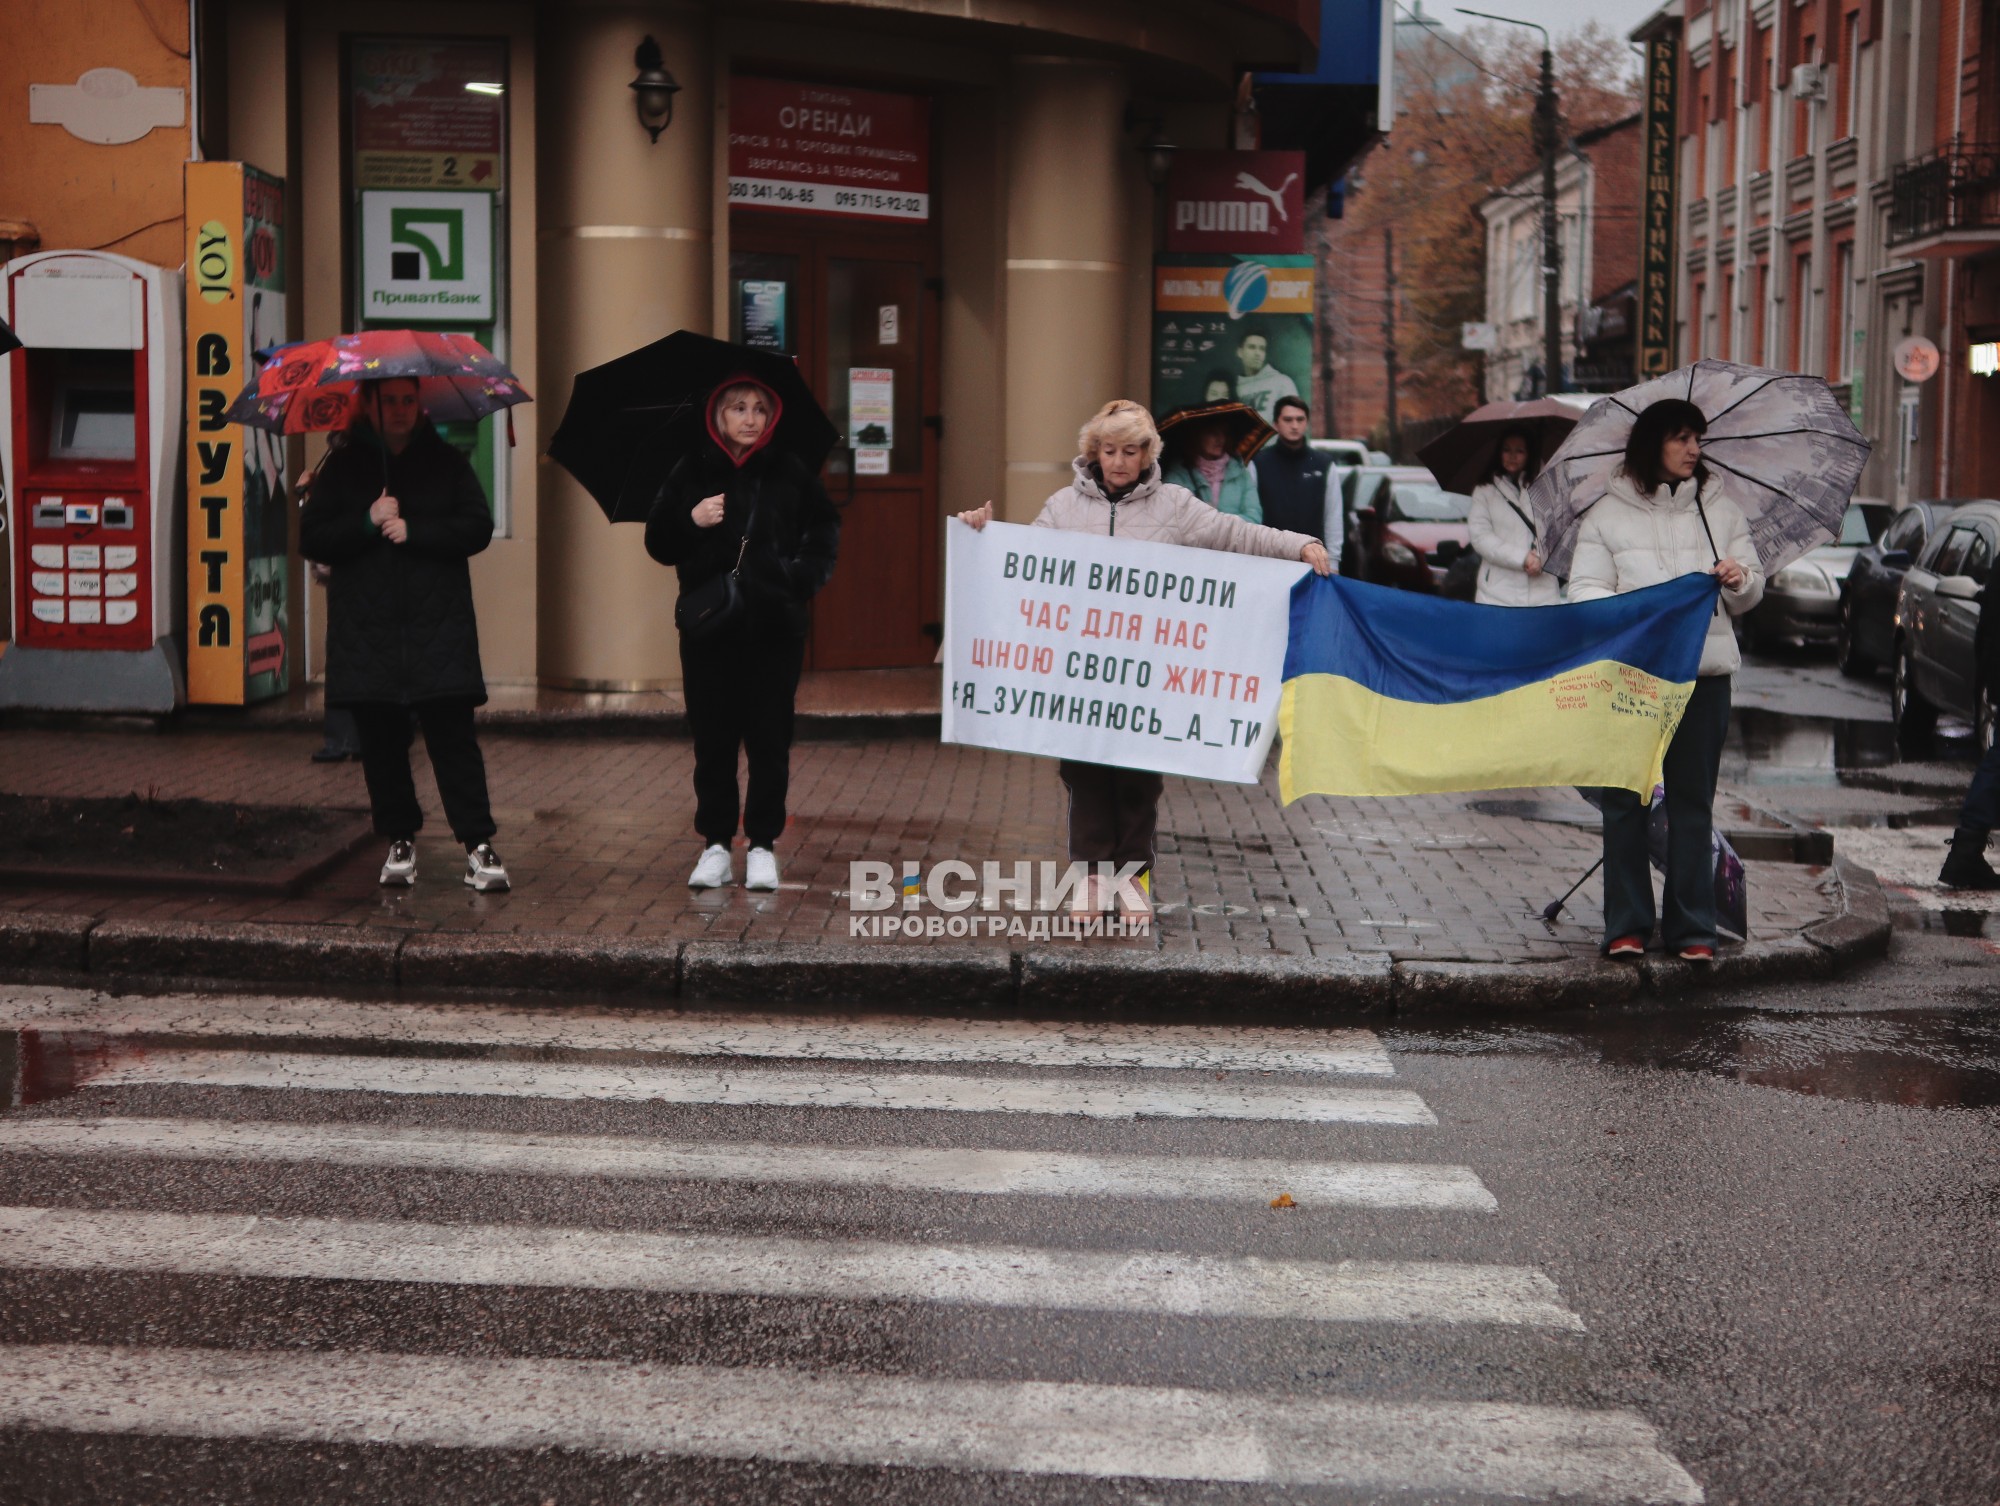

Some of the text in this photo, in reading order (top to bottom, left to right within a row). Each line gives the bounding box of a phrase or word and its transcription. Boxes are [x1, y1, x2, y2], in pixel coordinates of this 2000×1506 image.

[779, 106, 872, 137] ОРЕНДИ
[776, 138, 789, 148] ТА
[795, 140, 850, 156] ТОРГОВИХ
[443, 157, 457, 177] 2
[748, 157, 900, 182] ЗВЕРТАТИСЬ ЗА ТЕЛЕФОНОМ
[752, 184, 814, 203] 341-06-85
[835, 192, 857, 206] 095
[862, 194, 921, 212] 715-92-02
[1176, 201, 1269, 232] PUMA
[200, 227, 235, 300] JOY
[373, 289, 481, 306] ПриватБанк
[196, 333, 231, 647] ВЗУТТЯ
[1003, 551, 1237, 608] ВОНИ ВИБОРОЛИ
[1019, 599, 1208, 650] ЧАС ДЛЯ НАС
[971, 638, 1260, 703] ЦІНОЮ СВОГО ЖИТТЯ
